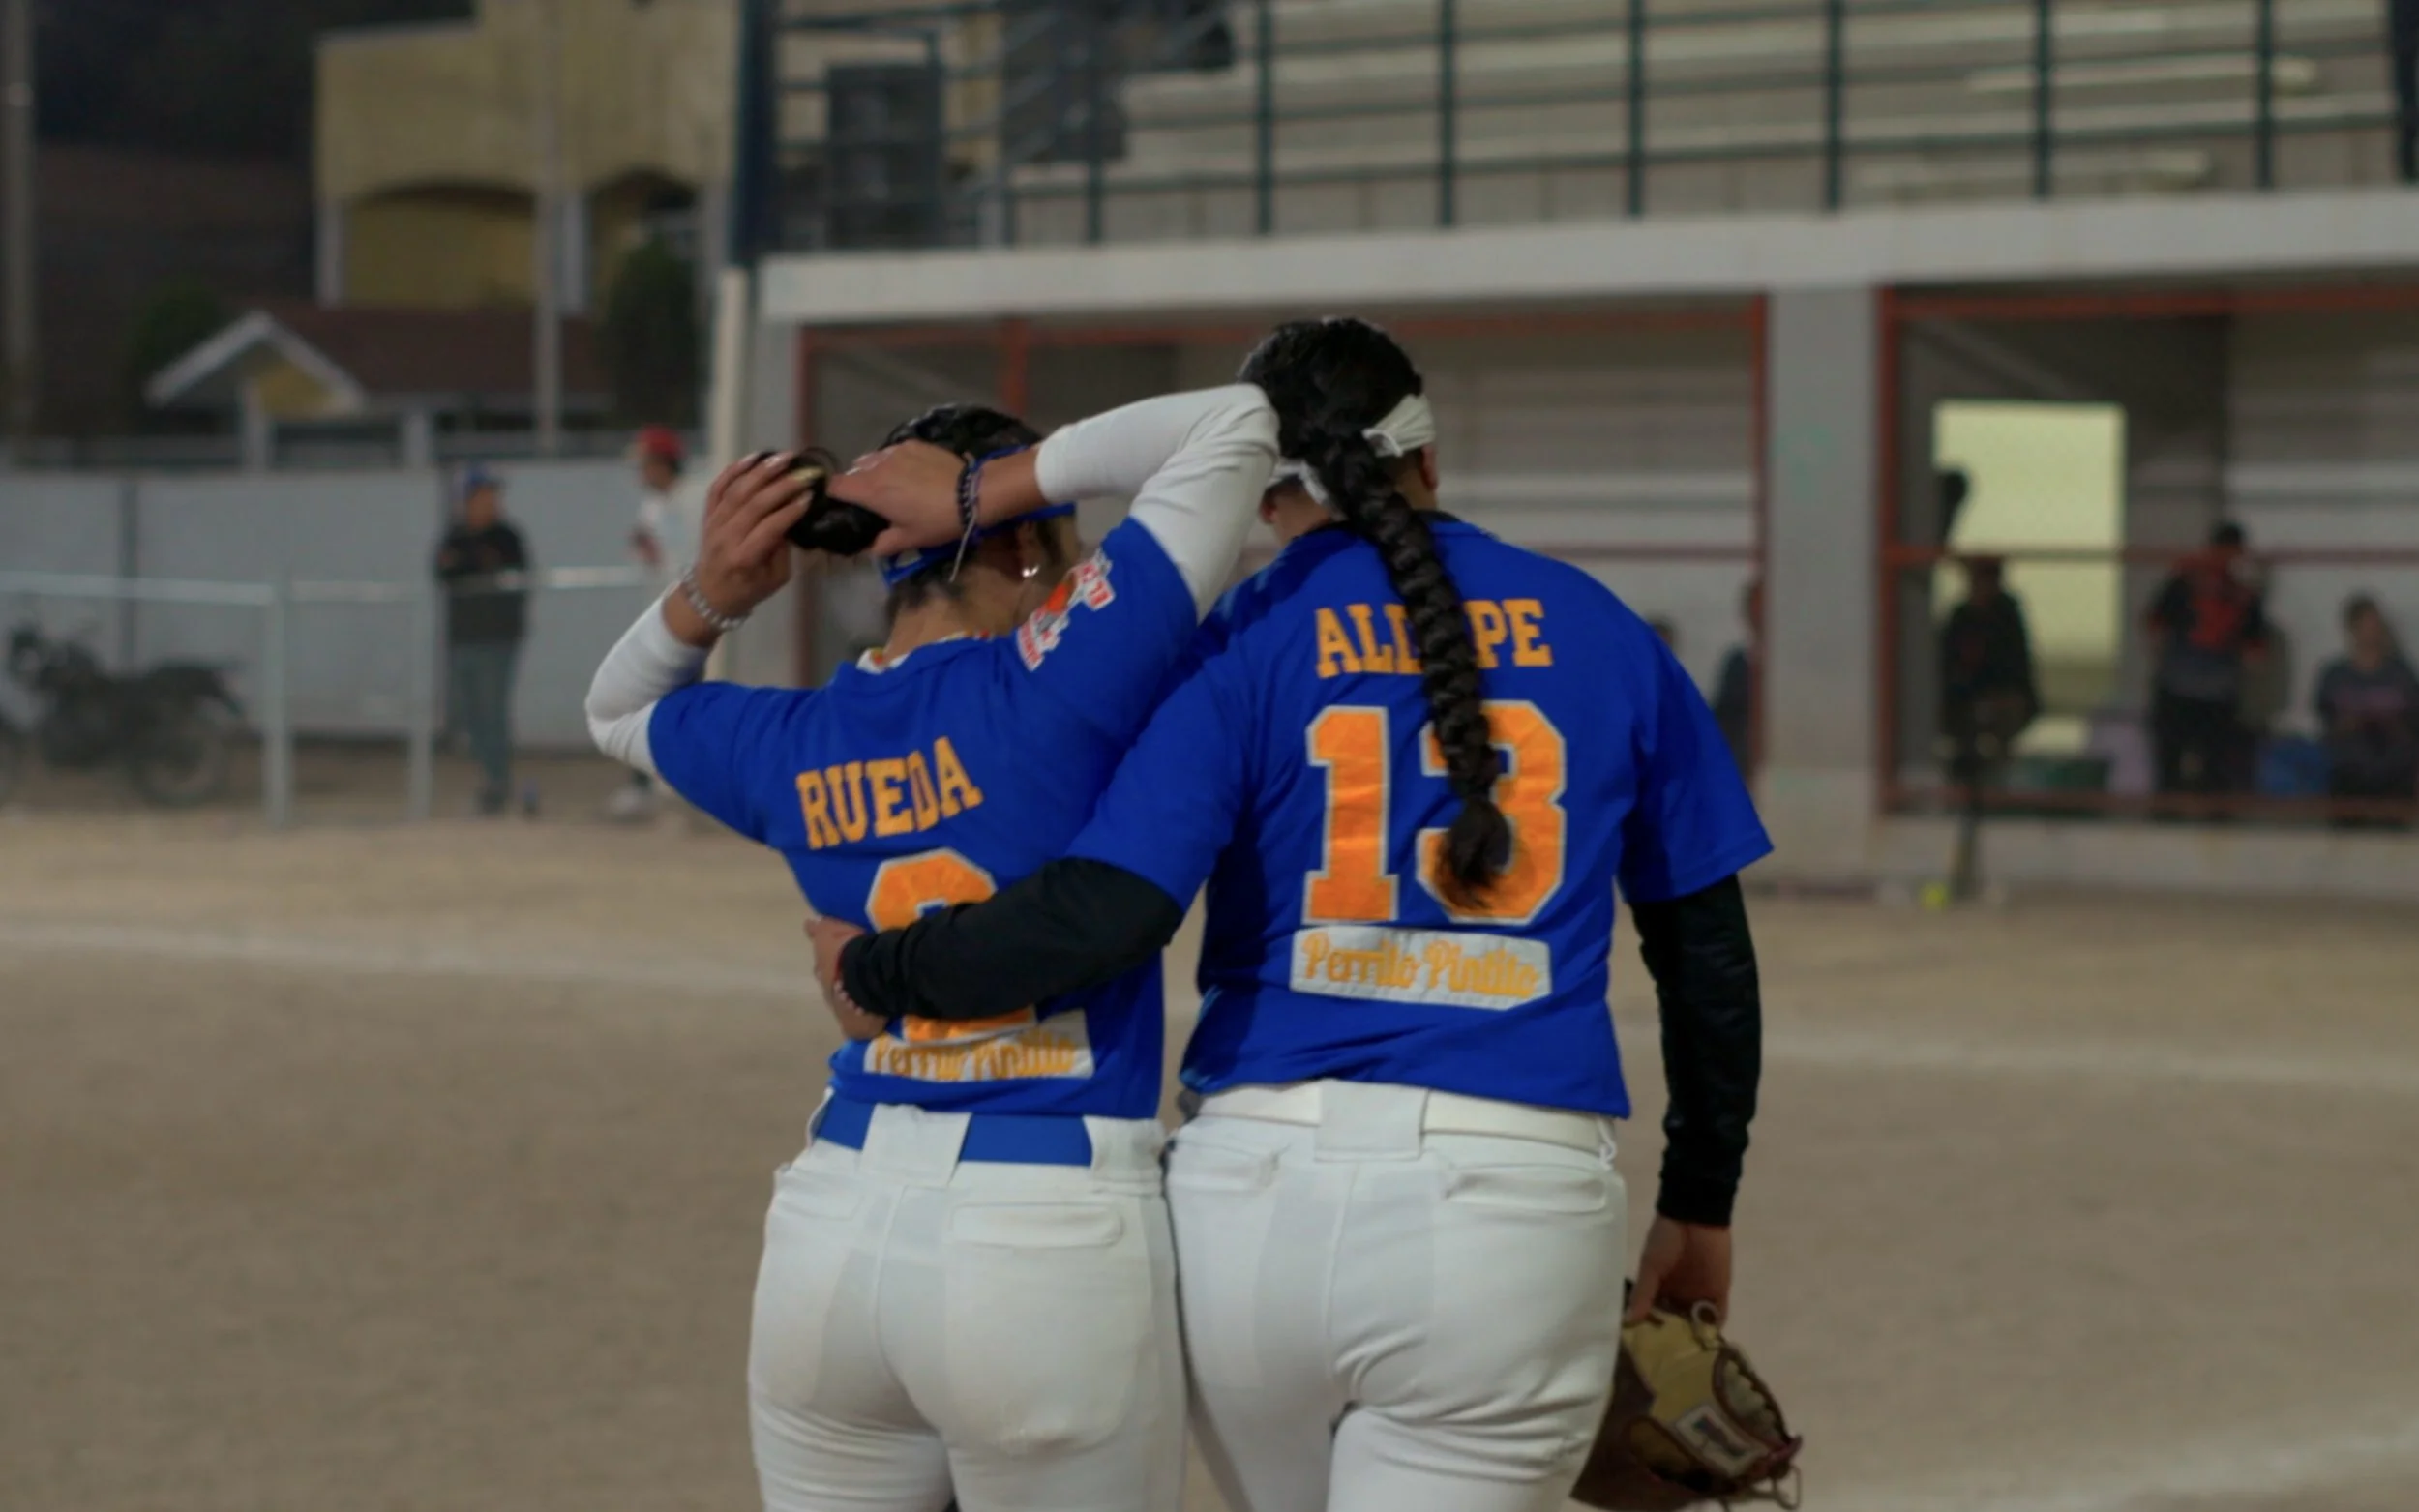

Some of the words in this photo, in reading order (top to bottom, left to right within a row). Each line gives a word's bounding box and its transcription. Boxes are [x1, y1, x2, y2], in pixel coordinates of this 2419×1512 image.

[1316, 599, 1552, 679] ALPE
[795, 735, 984, 850] RUEDA
[1301, 700, 1567, 926] 13
